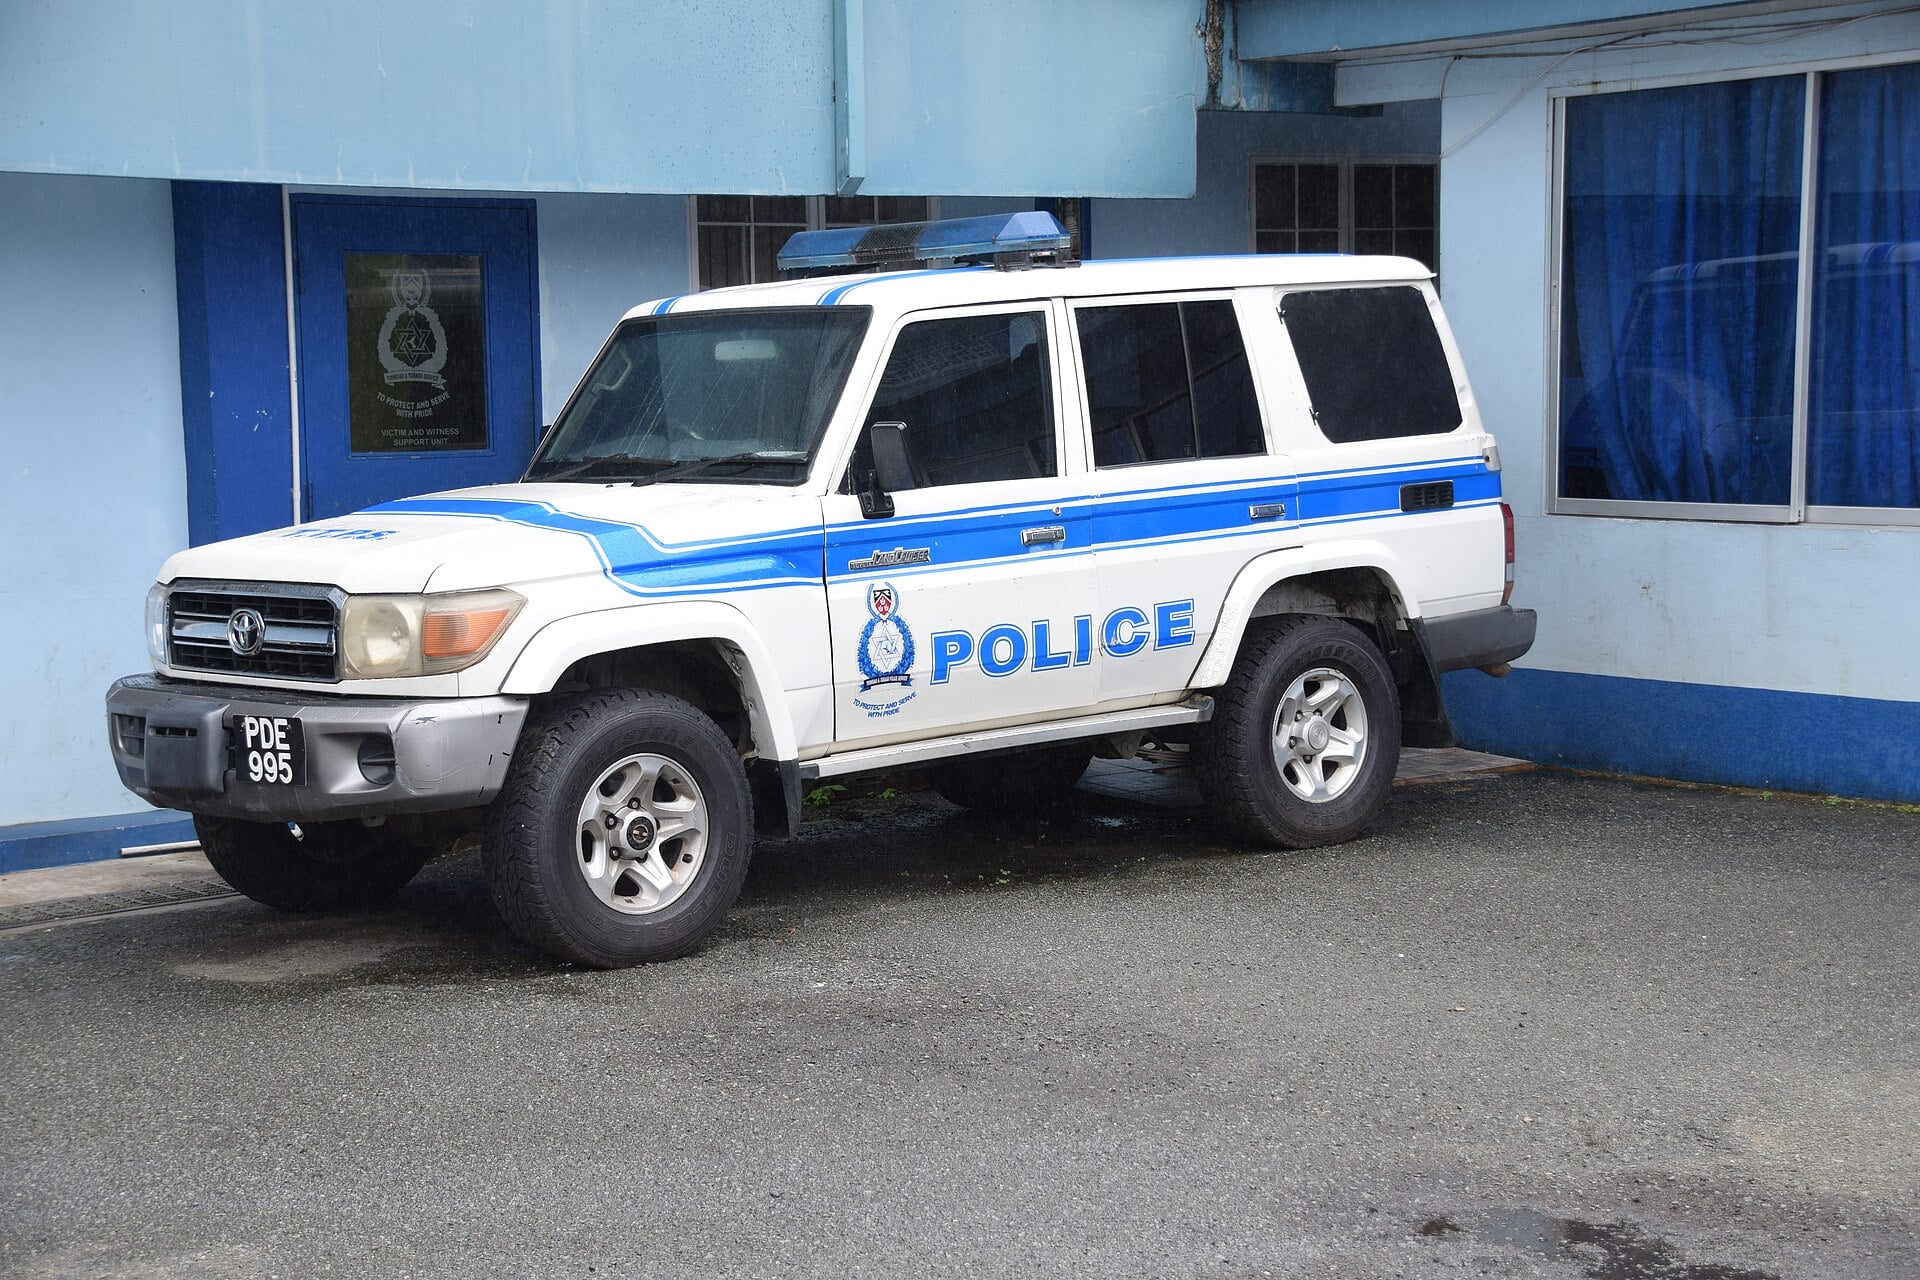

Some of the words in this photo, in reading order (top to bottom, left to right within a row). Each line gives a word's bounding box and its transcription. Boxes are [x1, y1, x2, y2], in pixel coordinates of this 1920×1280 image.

[376, 391, 386, 402] TO
[386, 397, 416, 409] PROTECT
[416, 400, 430, 409] AND
[430, 391, 451, 406] SERVE
[396, 409, 413, 418] WITH
[414, 408, 433, 418] PRIDE
[381, 429, 406, 437] VICTIM
[425, 428, 460, 436] WITNESS
[431, 438, 448, 446] UNIT
[929, 598, 1196, 685] POLICE
[853, 698, 861, 707] TO
[860, 701, 885, 711] PROTECT
[885, 701, 898, 710] AND
[898, 691, 917, 705] SERVE
[244, 716, 290, 750] PDE
[248, 750, 293, 784] 995
[656, 831, 737, 940] DUELER
